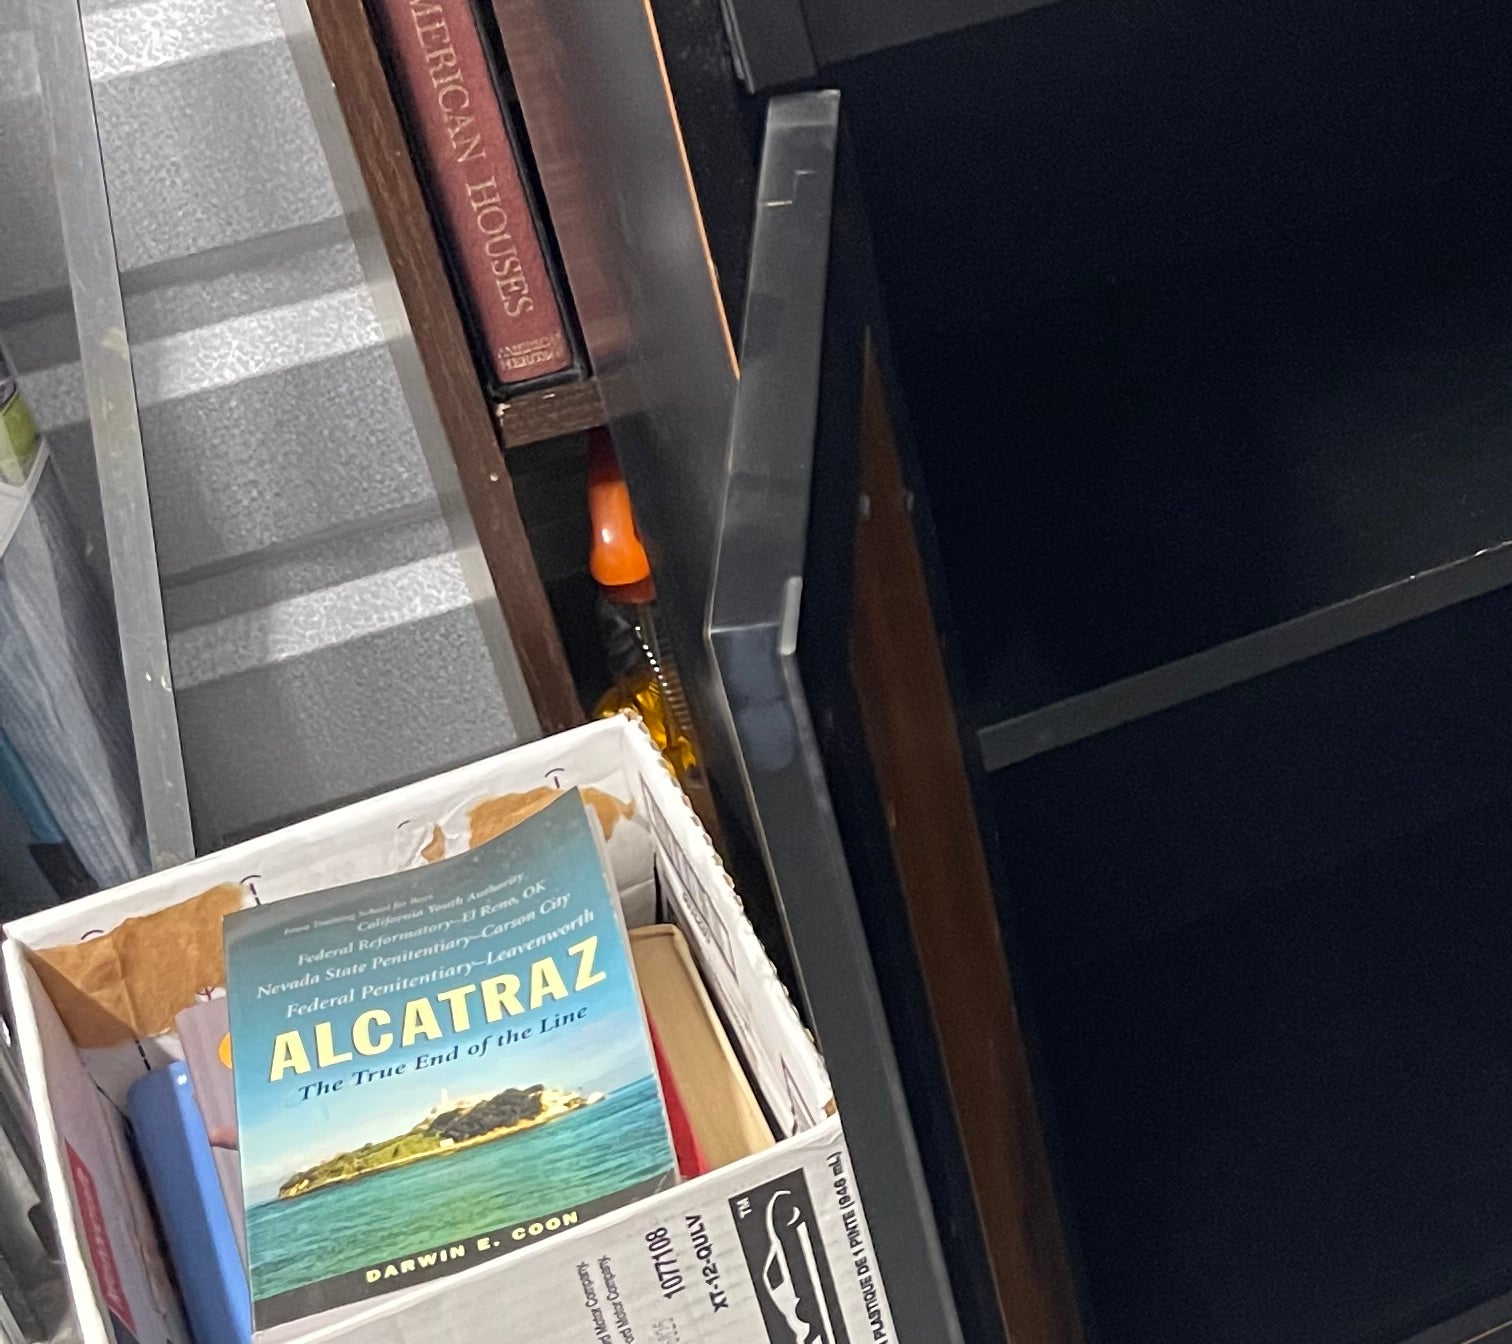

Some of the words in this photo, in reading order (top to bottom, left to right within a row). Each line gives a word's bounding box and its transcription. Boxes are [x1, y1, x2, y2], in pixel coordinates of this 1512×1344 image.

[465, 175, 535, 318] HOUSES
[298, 941, 354, 967] Federal
[522, 878, 547, 899] OK
[357, 908, 424, 933] California
[428, 895, 464, 915] Youth
[466, 871, 525, 902] Authority
[256, 973, 321, 1000] Nevada
[325, 960, 368, 982] State
[539, 892, 571, 915] City
[268, 935, 607, 1083] ALCATRAZ
[285, 988, 355, 1019] Federal
[298, 1078, 344, 1102] The
[351, 1062, 408, 1087] True
[414, 1045, 459, 1071] End
[466, 1030, 492, 1055] of
[497, 1023, 533, 1047] the
[539, 1006, 589, 1034] Line
[365, 1244, 466, 1284] DARWIN
[476, 1237, 501, 1252] E.
[511, 1210, 579, 1241] COON
[644, 1226, 686, 1300] 1077108
[684, 1213, 729, 1313] XT-12-QULV
[842, 1208, 864, 1250] PINTE
[854, 1258, 870, 1277] DE
[590, 1307, 609, 1336] Motor
[611, 1301, 631, 1329] Motor
[859, 1274, 889, 1343] PLASTIQUE
